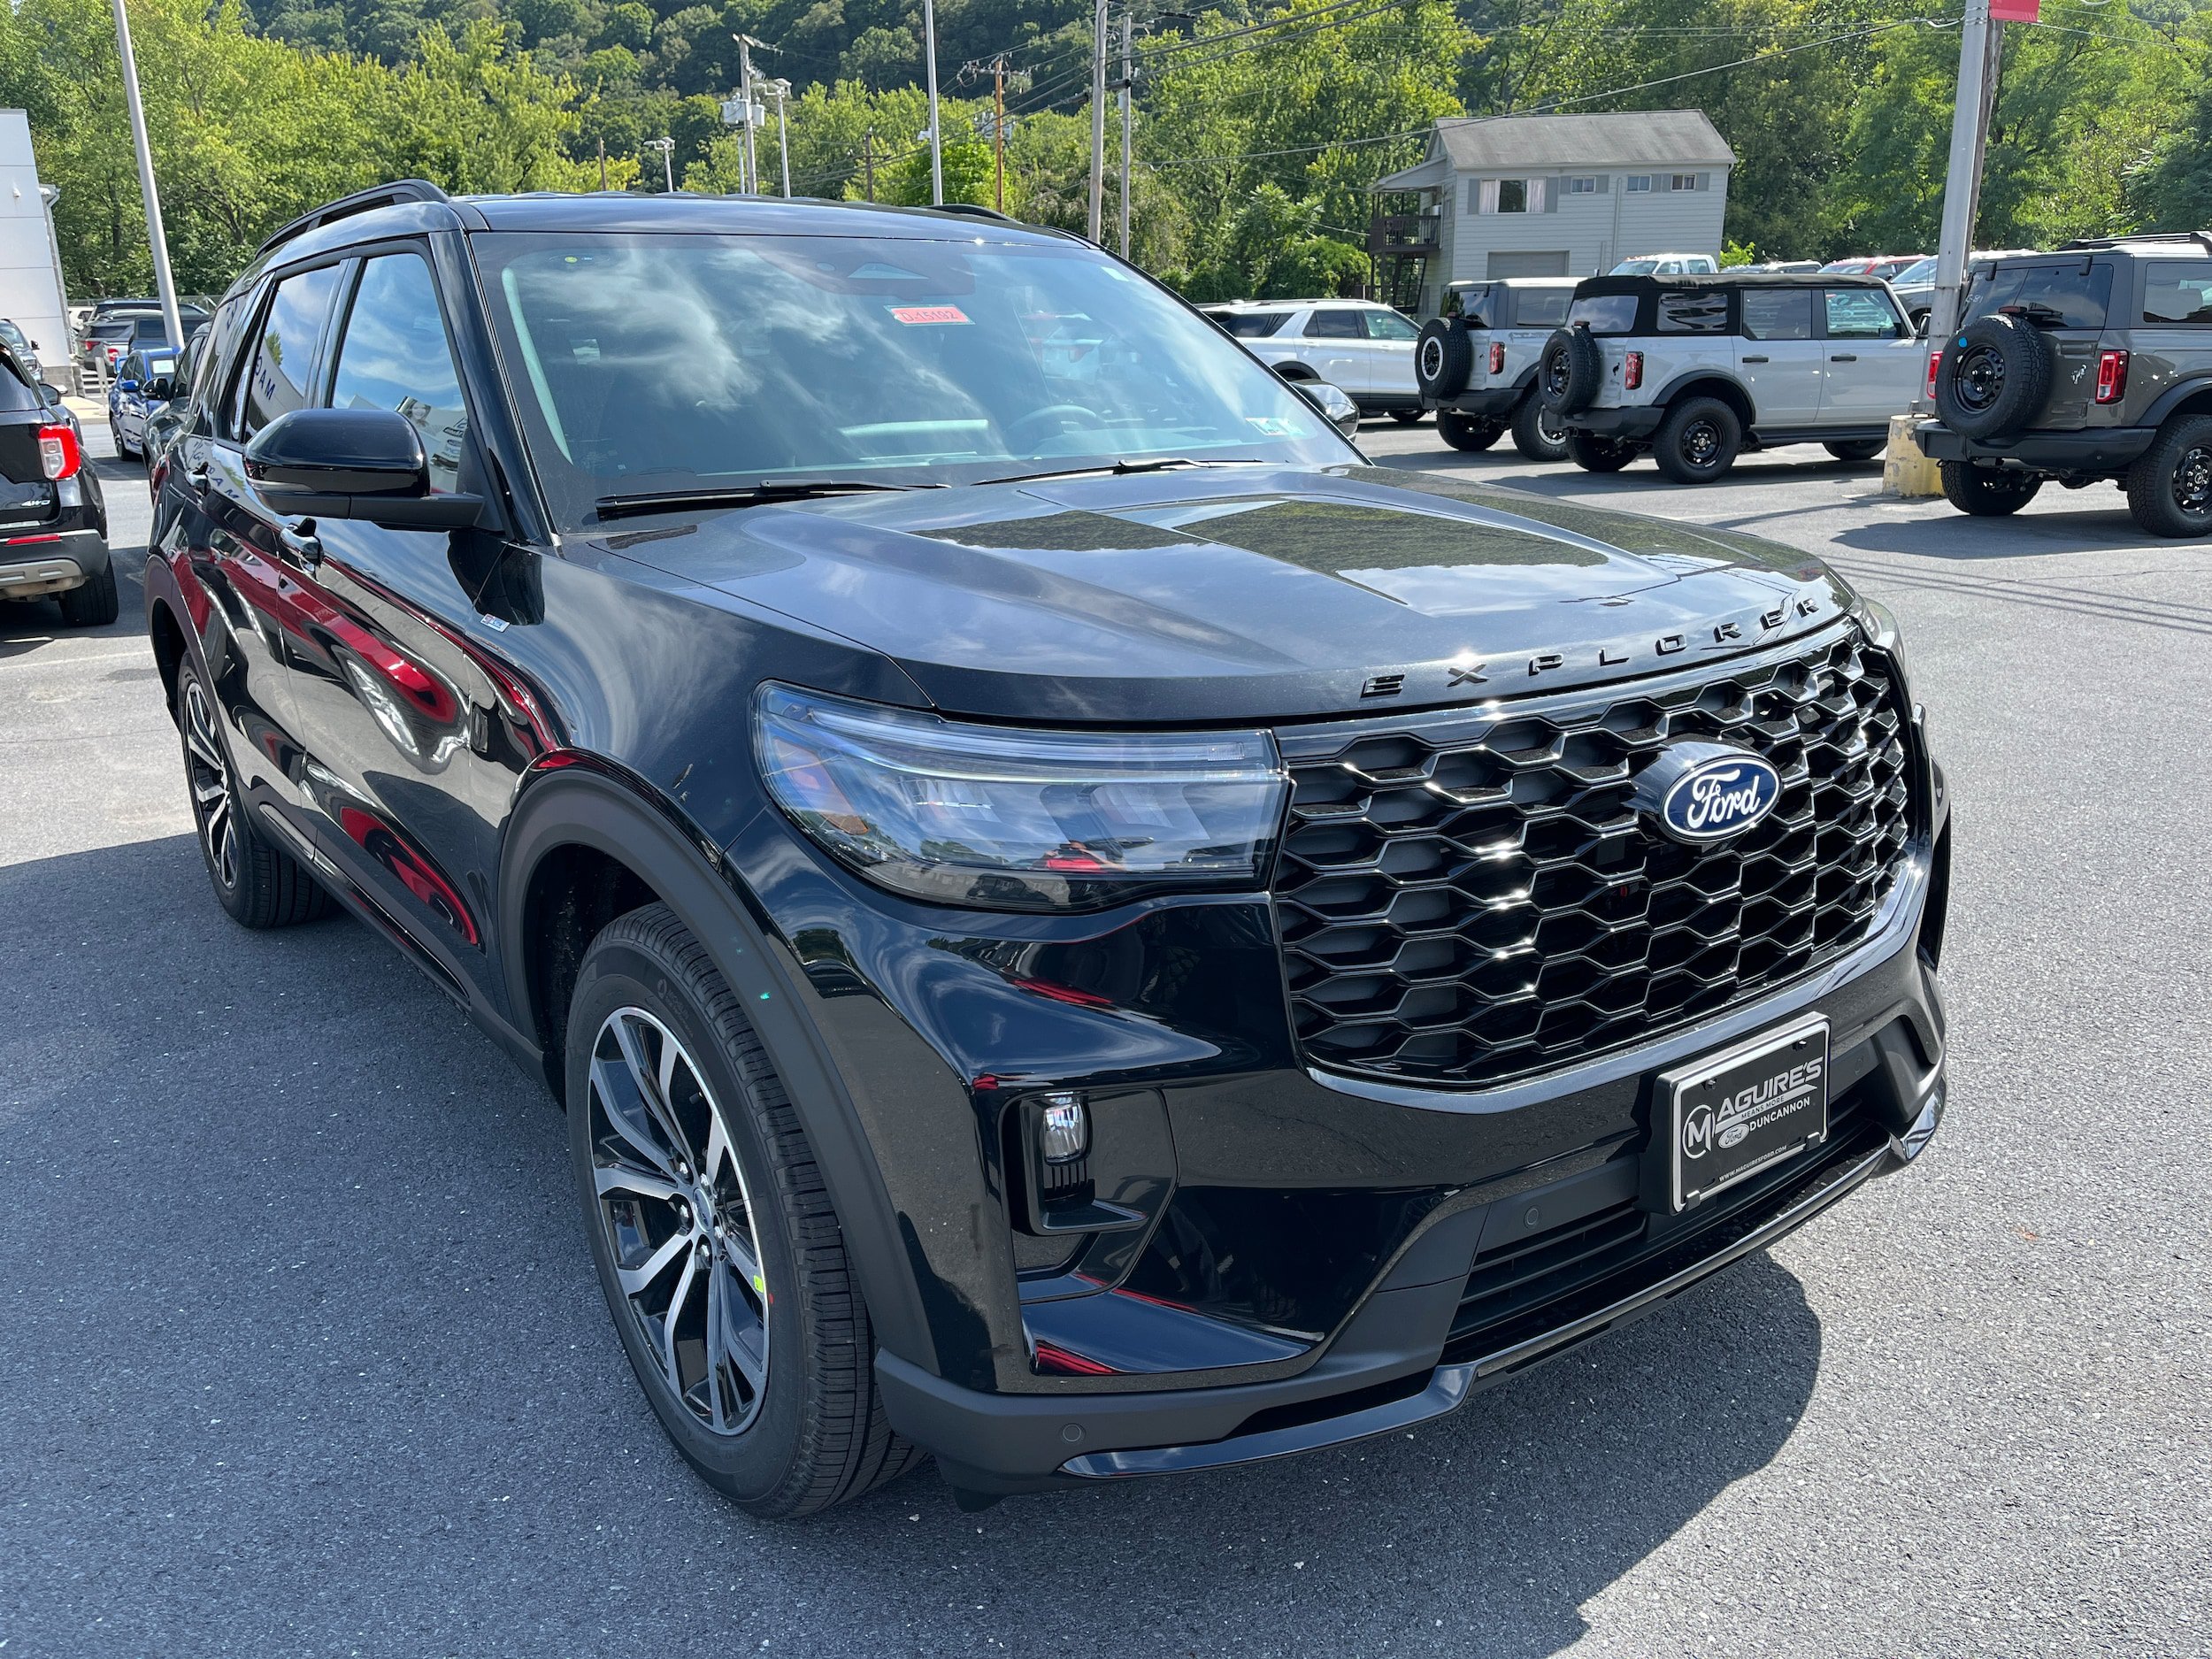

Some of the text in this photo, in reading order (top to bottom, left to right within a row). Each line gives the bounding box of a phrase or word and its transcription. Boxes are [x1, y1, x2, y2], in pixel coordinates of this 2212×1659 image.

[1361, 597, 1819, 698] EXPLORER
[1686, 768, 1761, 829] Ford
[1740, 1095, 1785, 1120] MEANS MORE
[1749, 1096, 1810, 1132] DUNCANNON
